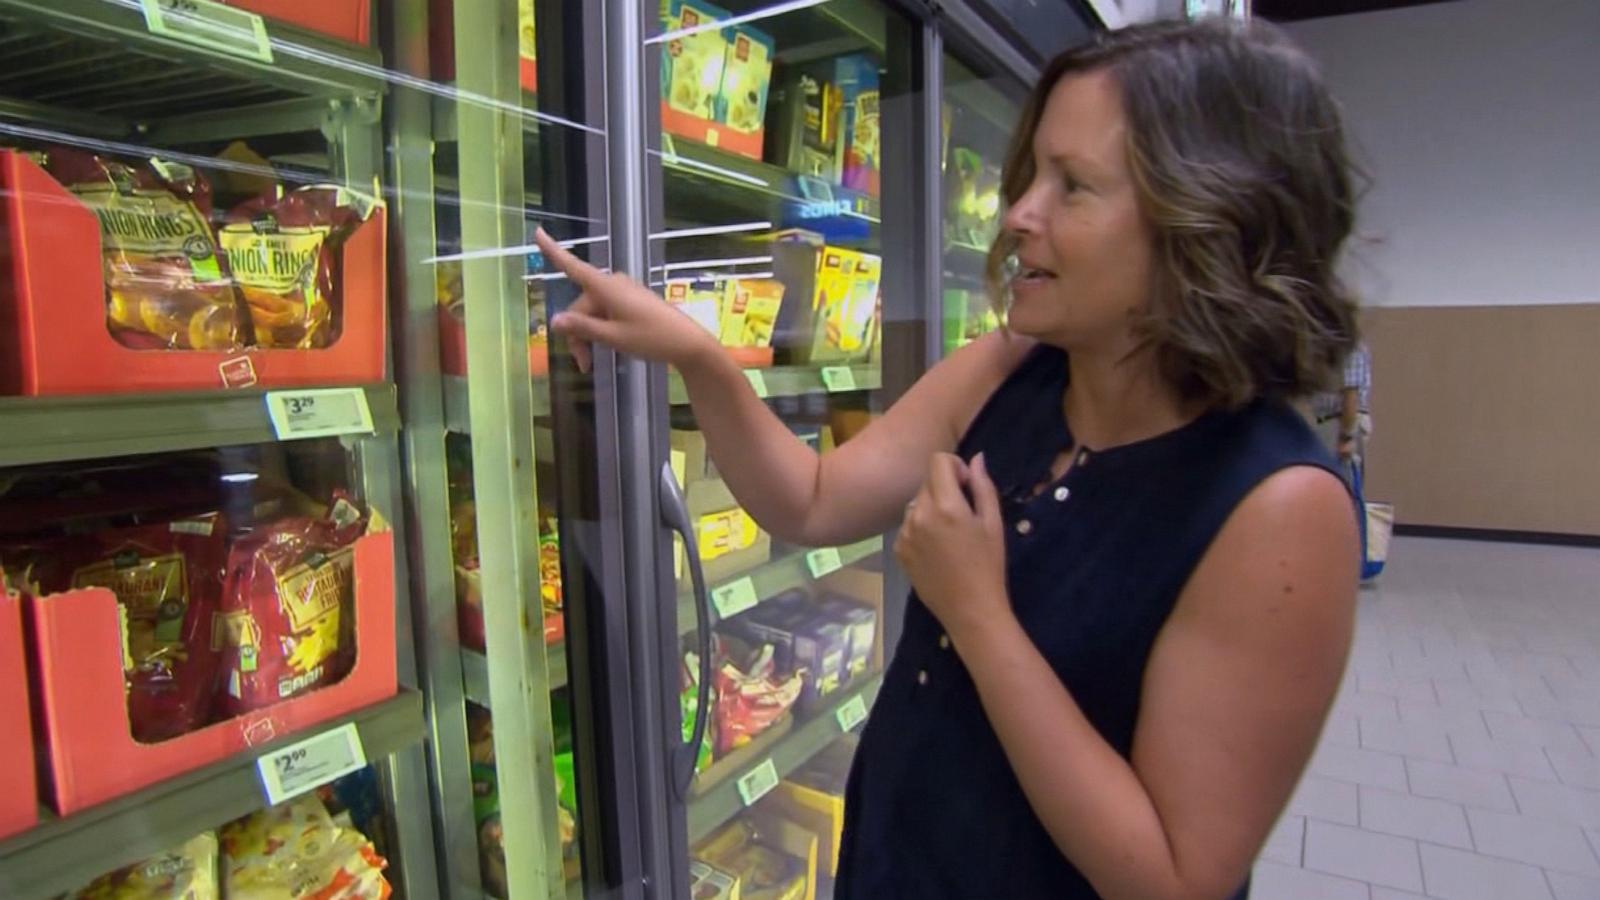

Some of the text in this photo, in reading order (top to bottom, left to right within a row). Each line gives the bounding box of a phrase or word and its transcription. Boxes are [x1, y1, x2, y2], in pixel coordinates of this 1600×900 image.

[97, 207, 195, 239] NION RINGS
[227, 246, 312, 277] NION RING
